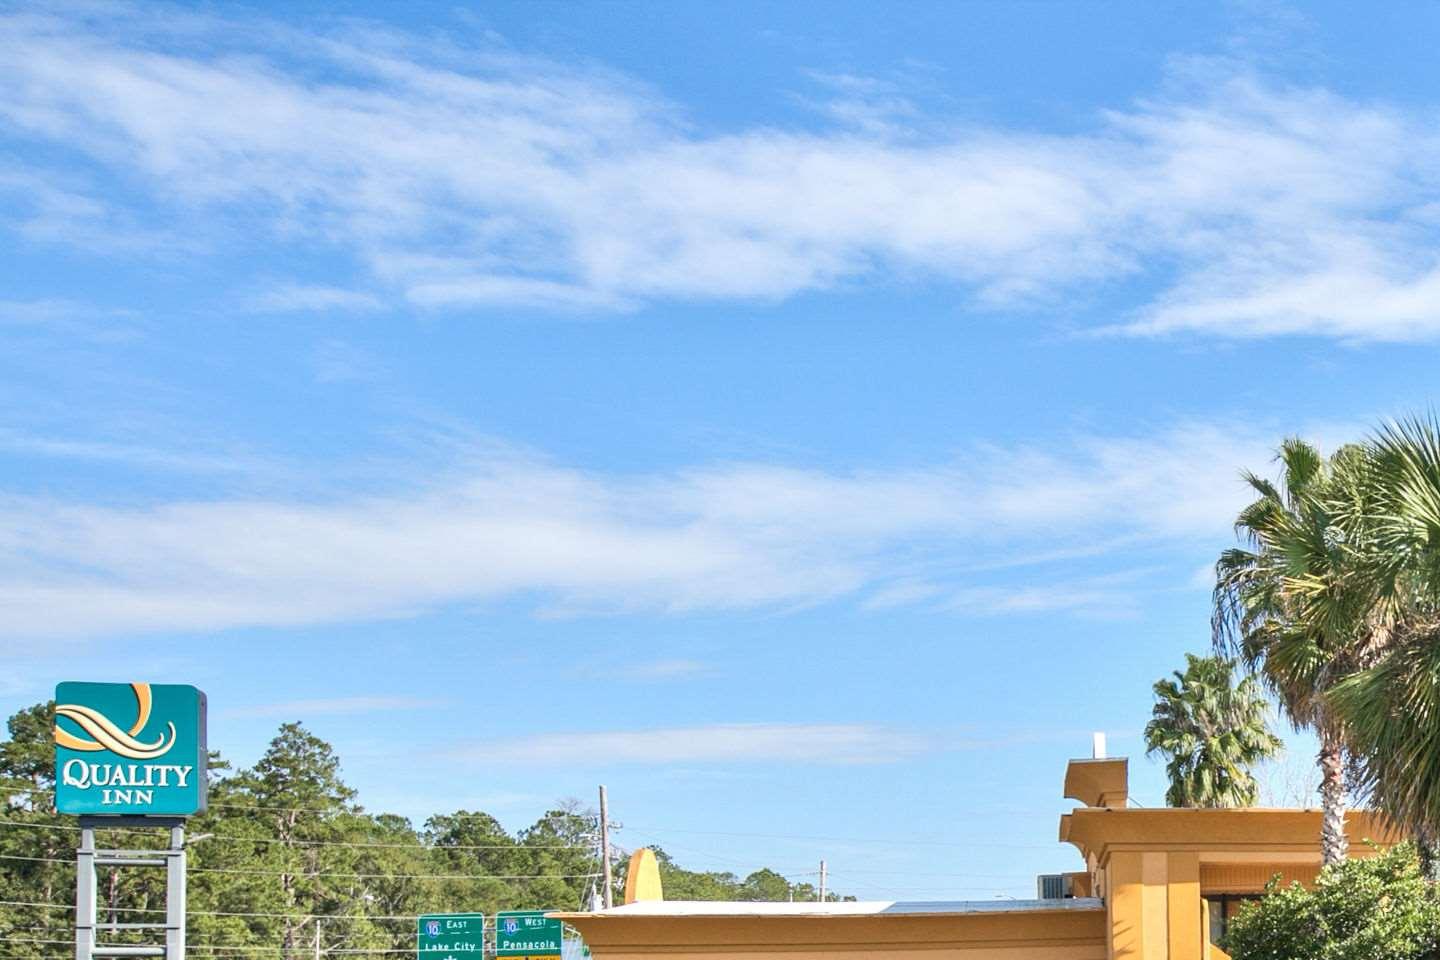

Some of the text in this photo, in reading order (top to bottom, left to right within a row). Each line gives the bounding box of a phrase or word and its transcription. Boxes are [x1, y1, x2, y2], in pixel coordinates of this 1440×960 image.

[62, 759, 193, 789] QUALITY
[101, 789, 154, 805] INN
[425, 941, 476, 953] Lake City
[503, 940, 556, 950] Pensacola
